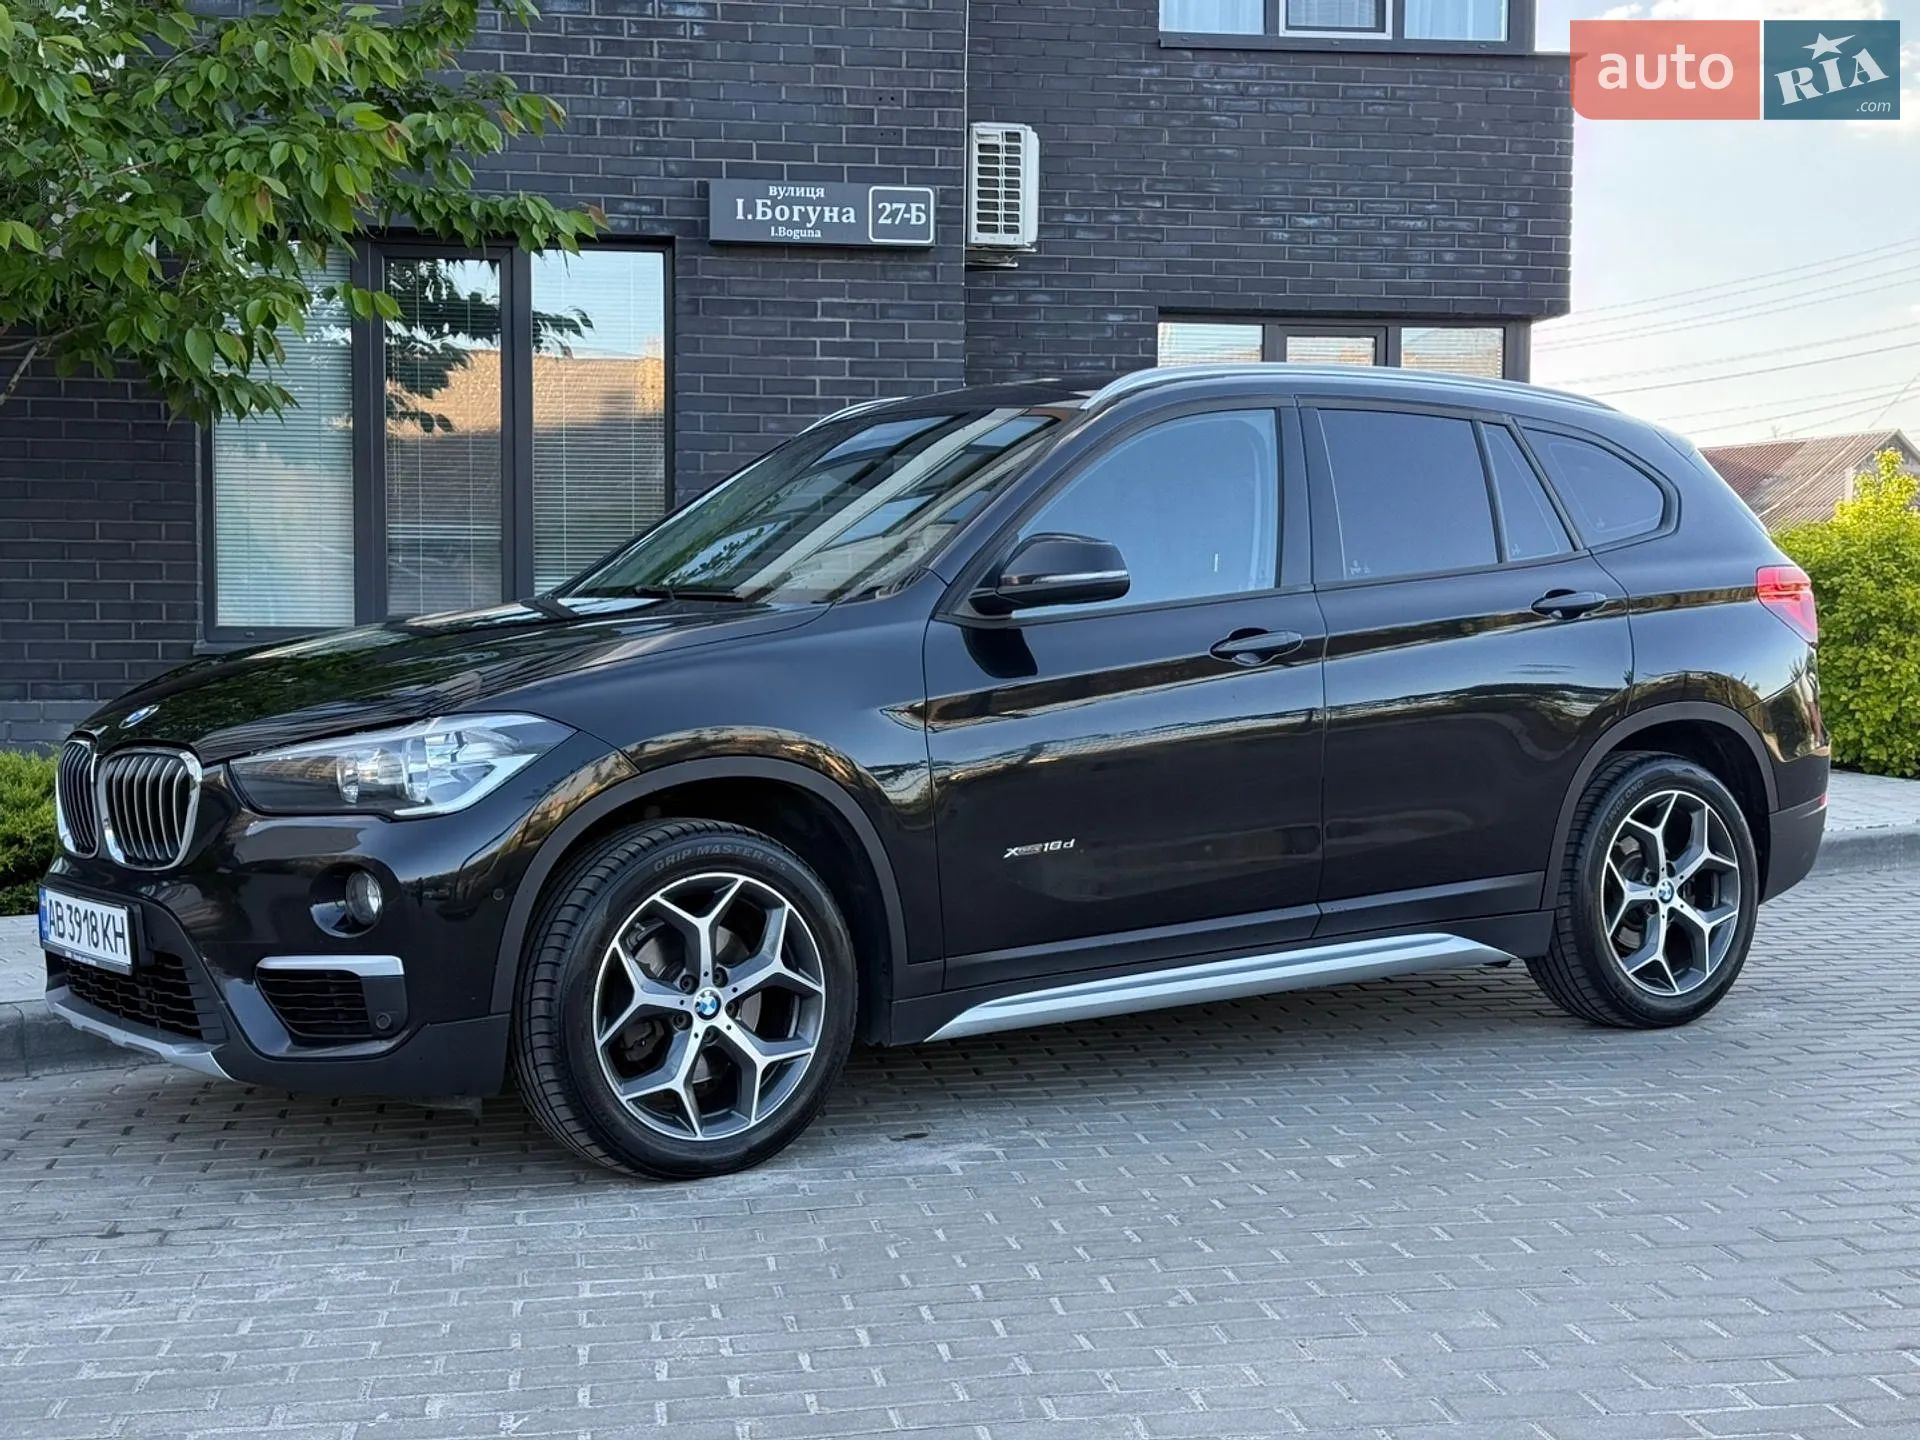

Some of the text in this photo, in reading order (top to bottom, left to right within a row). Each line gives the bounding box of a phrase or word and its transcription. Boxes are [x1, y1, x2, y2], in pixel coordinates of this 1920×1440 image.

[768, 185, 825, 200] вулиця
[877, 202, 927, 226] 27-Б
[770, 226, 821, 240] I.Boguna
[653, 848, 692, 872] GRIP
[696, 844, 764, 861] MASTER
